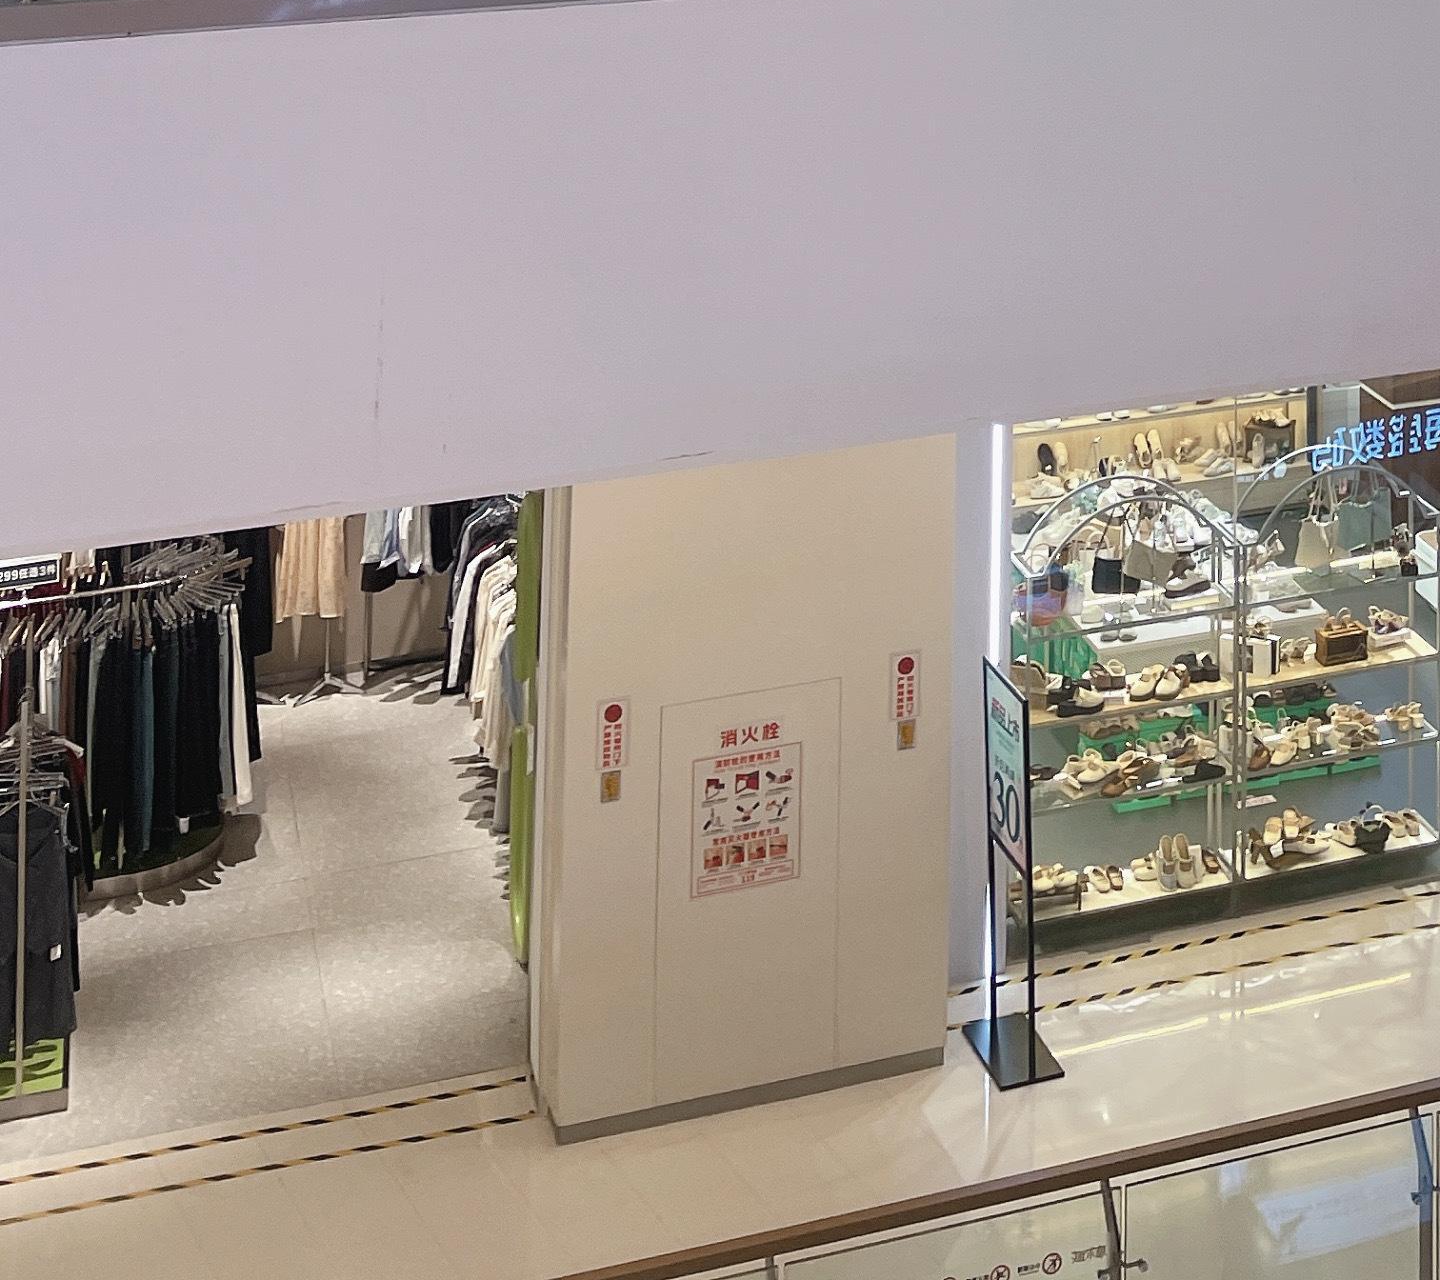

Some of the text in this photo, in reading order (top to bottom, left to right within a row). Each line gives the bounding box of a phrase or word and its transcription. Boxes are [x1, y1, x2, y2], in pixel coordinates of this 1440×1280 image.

[720, 722, 780, 749] 消火栓
[993, 771, 1020, 844] 30
